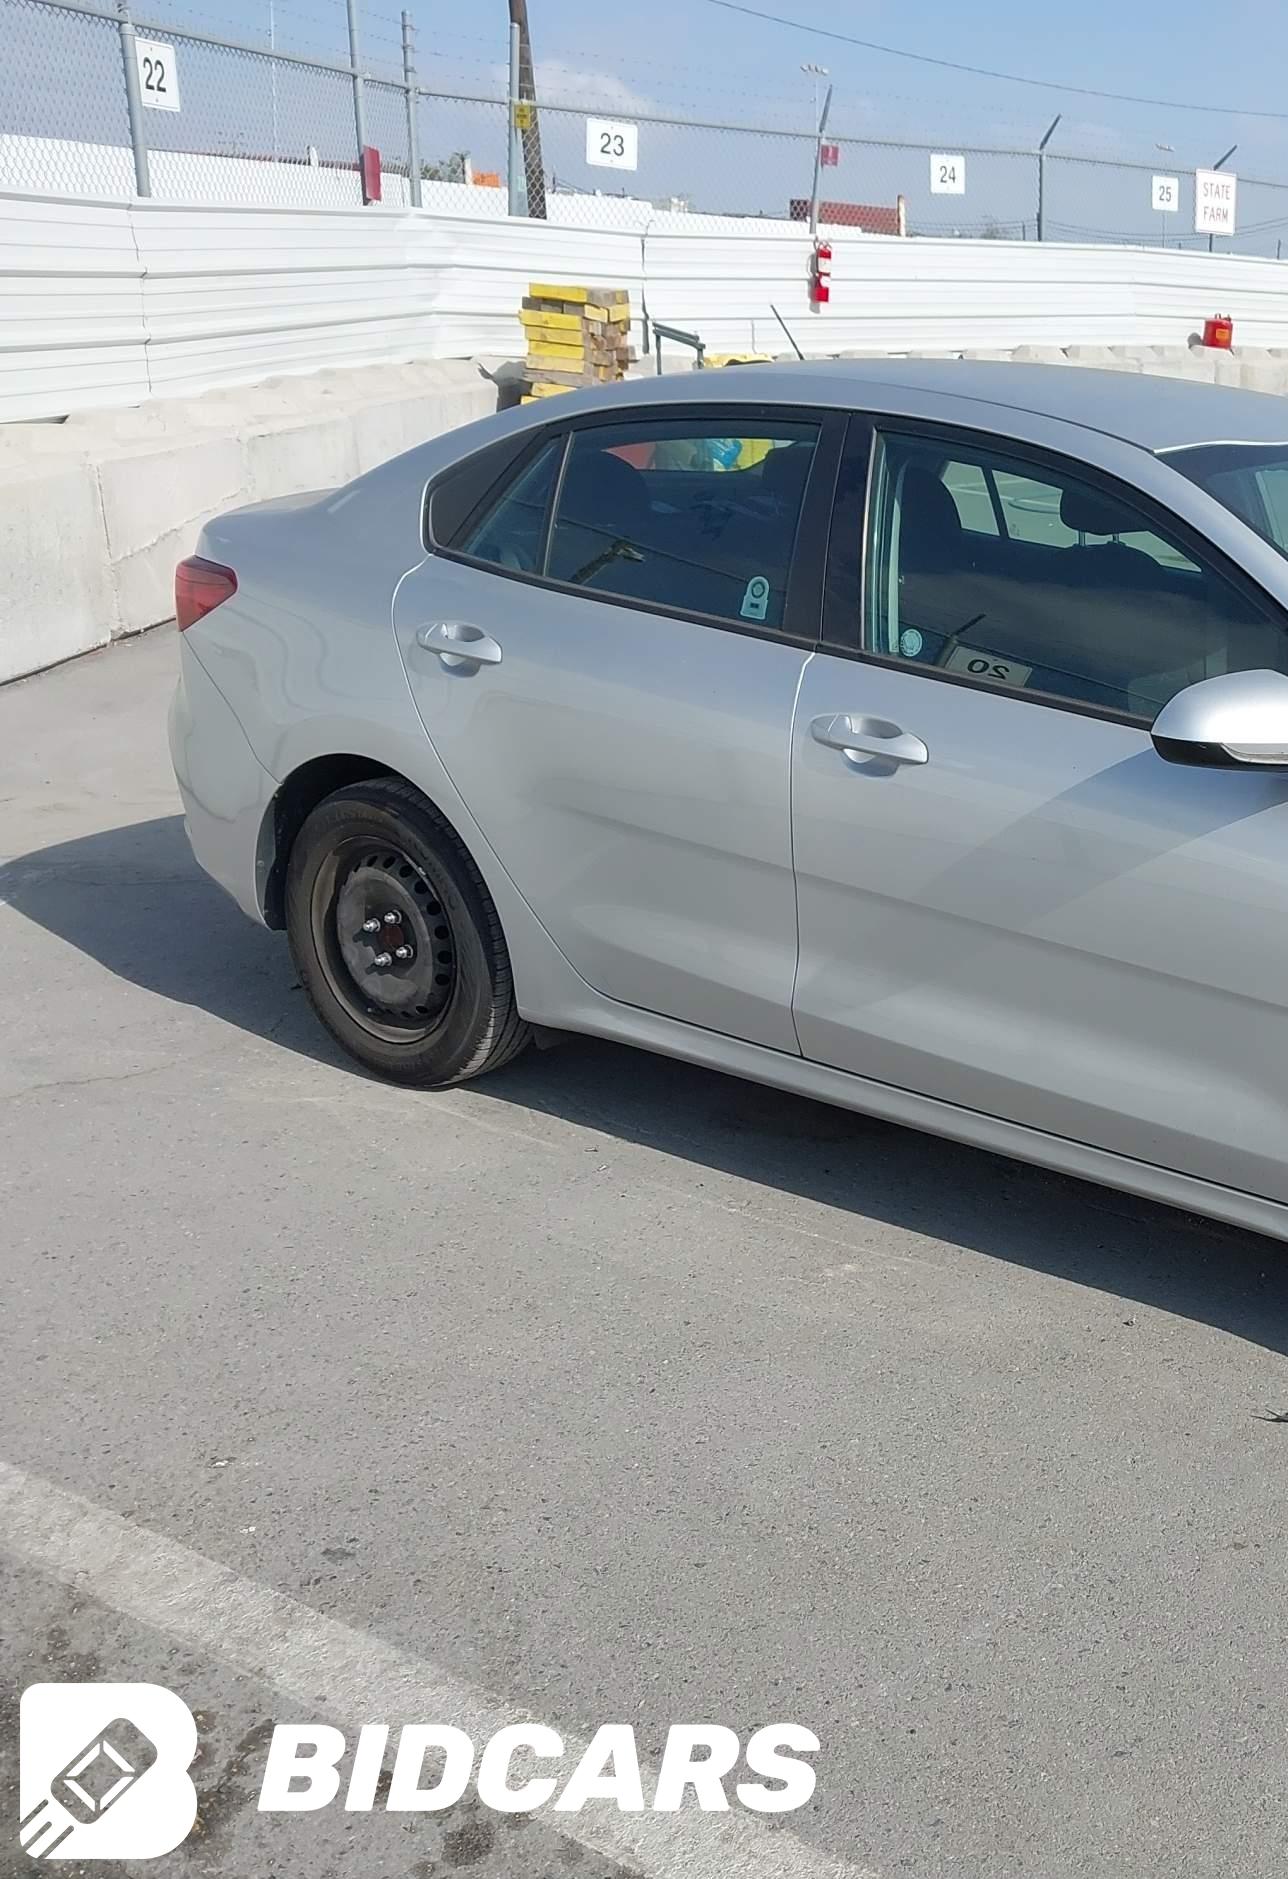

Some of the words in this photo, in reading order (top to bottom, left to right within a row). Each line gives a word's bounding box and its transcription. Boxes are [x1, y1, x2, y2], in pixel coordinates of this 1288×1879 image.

[143, 57, 167, 92] 22
[600, 132, 624, 156] 23
[940, 165, 956, 183] 24
[1159, 185, 1172, 202] 25
[1203, 182, 1231, 200] STATE
[1203, 206, 1229, 223] FARM
